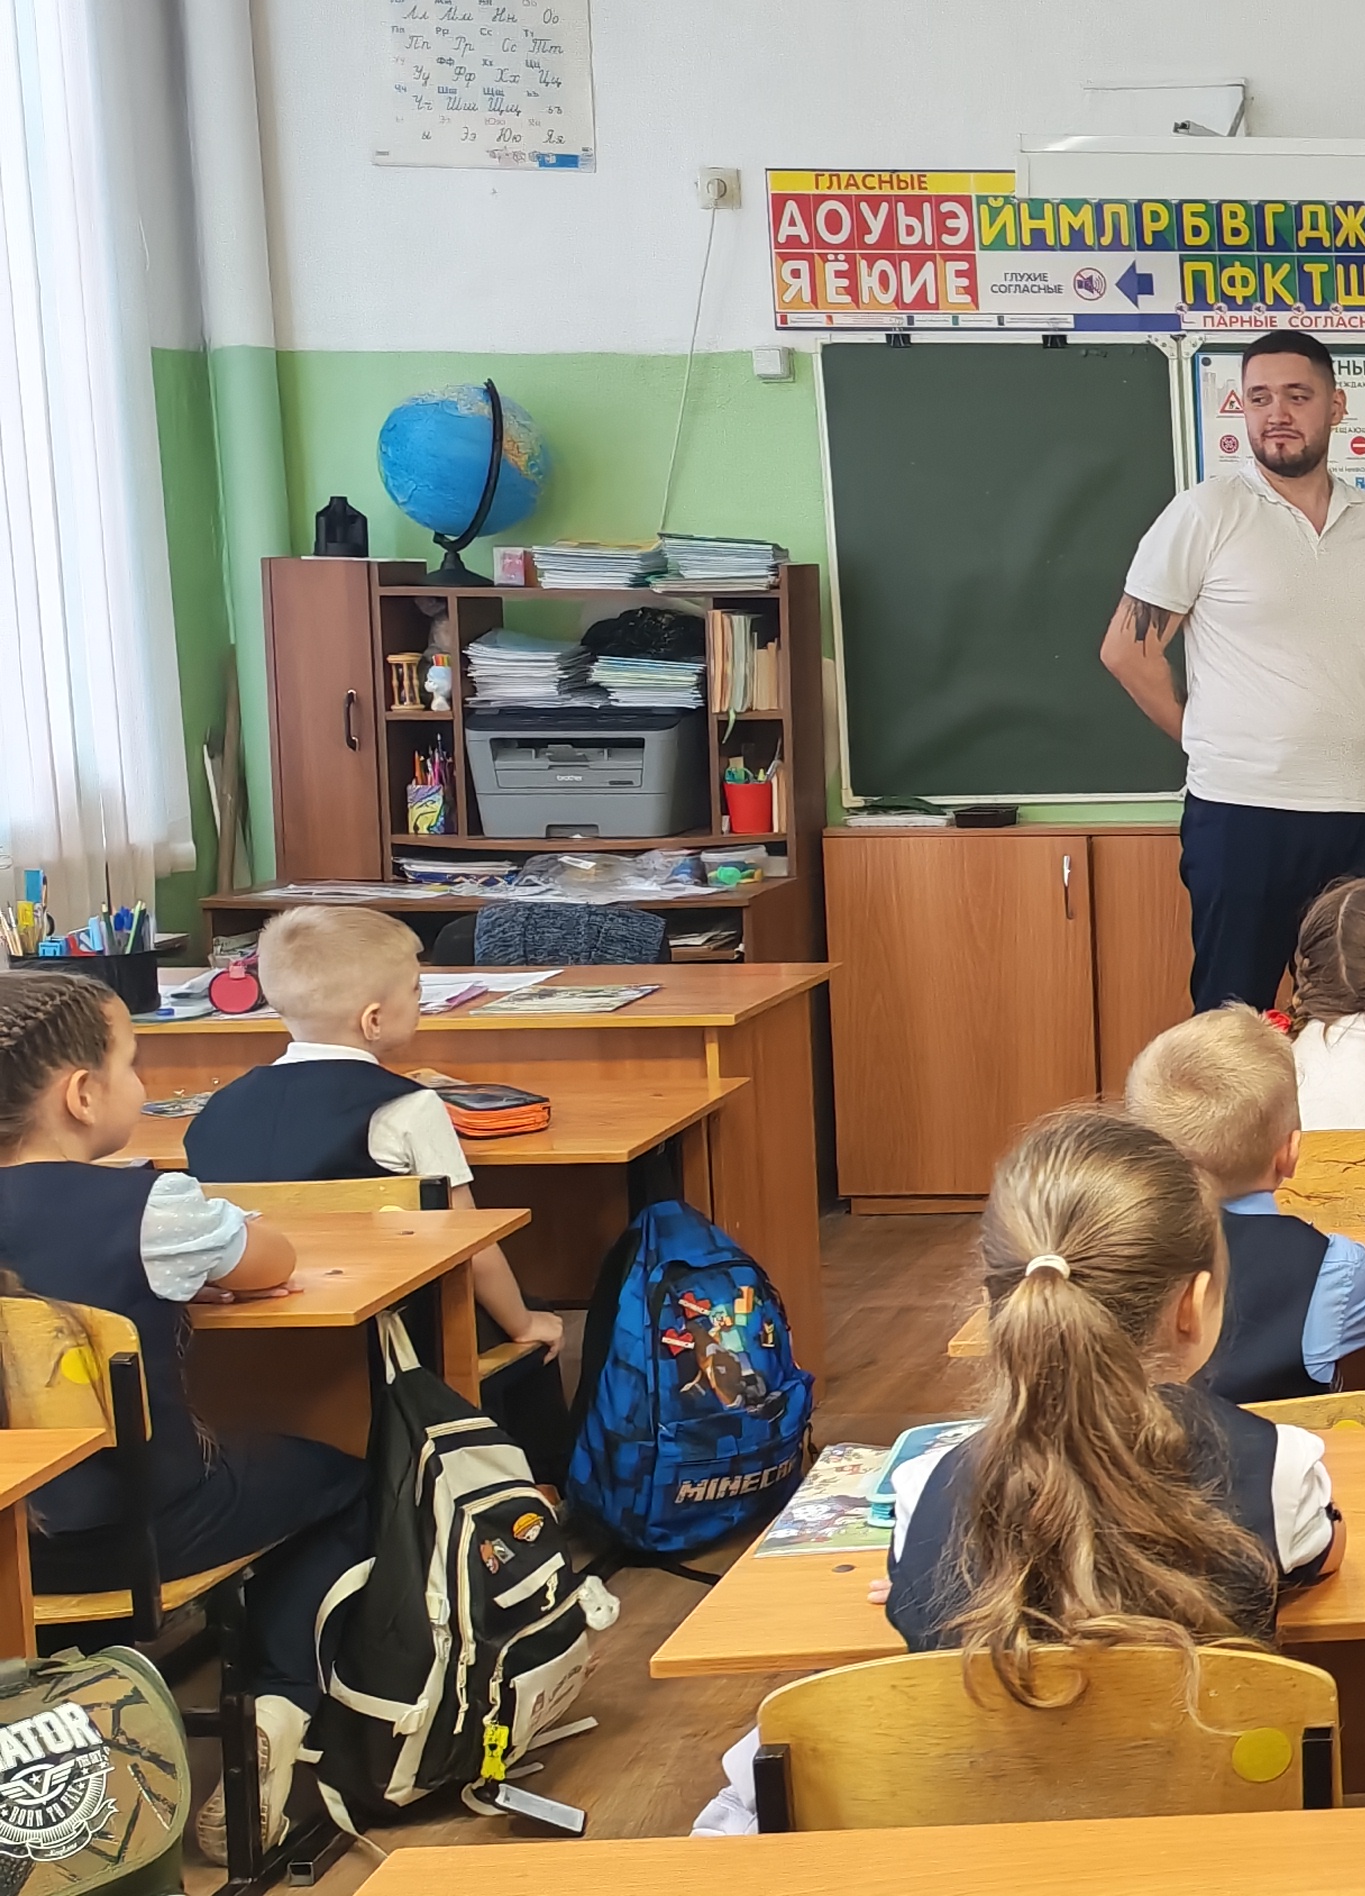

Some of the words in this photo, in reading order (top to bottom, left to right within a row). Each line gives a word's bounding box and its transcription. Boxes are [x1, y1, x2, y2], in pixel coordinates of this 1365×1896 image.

[439, 6, 474, 20] Мм
[491, 7, 518, 23] Нн
[543, 8, 559, 24] Оо
[404, 35, 431, 50] Пп
[452, 36, 475, 57] Рр
[502, 37, 517, 52] Сс
[452, 65, 476, 88] Фф
[494, 68, 520, 83] Хх
[539, 69, 562, 88] Цц
[447, 96, 478, 111] Шш
[488, 97, 522, 117] Щщ
[496, 127, 522, 143] Юю
[542, 129, 566, 144] Яя
[814, 173, 928, 190] ГЛАСНЫЕ
[777, 200, 810, 244] А
[815, 200, 851, 244] О
[859, 202, 889, 246] У
[897, 202, 933, 246] Ы
[939, 202, 969, 246] Э
[979, 196, 1016, 246] Й
[1019, 202, 1055, 246] Н
[1059, 202, 1094, 246] М
[1100, 202, 1129, 246] Л
[1142, 202, 1169, 246] Р
[1182, 202, 1210, 246] Б
[1222, 202, 1250, 246] В
[1264, 202, 1286, 246] Г
[1297, 204, 1331, 248] Д
[782, 260, 811, 303] Я
[825, 254, 852, 303] Ё
[860, 260, 898, 303] Ю
[901, 260, 936, 303] И
[946, 260, 971, 303] Е
[1003, 272, 1049, 283] ГЛУХИЕ
[1182, 262, 1215, 306] П
[1221, 262, 1256, 306] Ф
[1264, 262, 1295, 306] К
[1303, 262, 1329, 306] Т
[990, 283, 1064, 295] СОГЛАСНЫЕ
[1202, 315, 1278, 329] ПАРНЫЕ
[9, 1806, 43, 1827] BORN
[46, 1802, 66, 1823] TO
[61, 1783, 85, 1809] FLY
